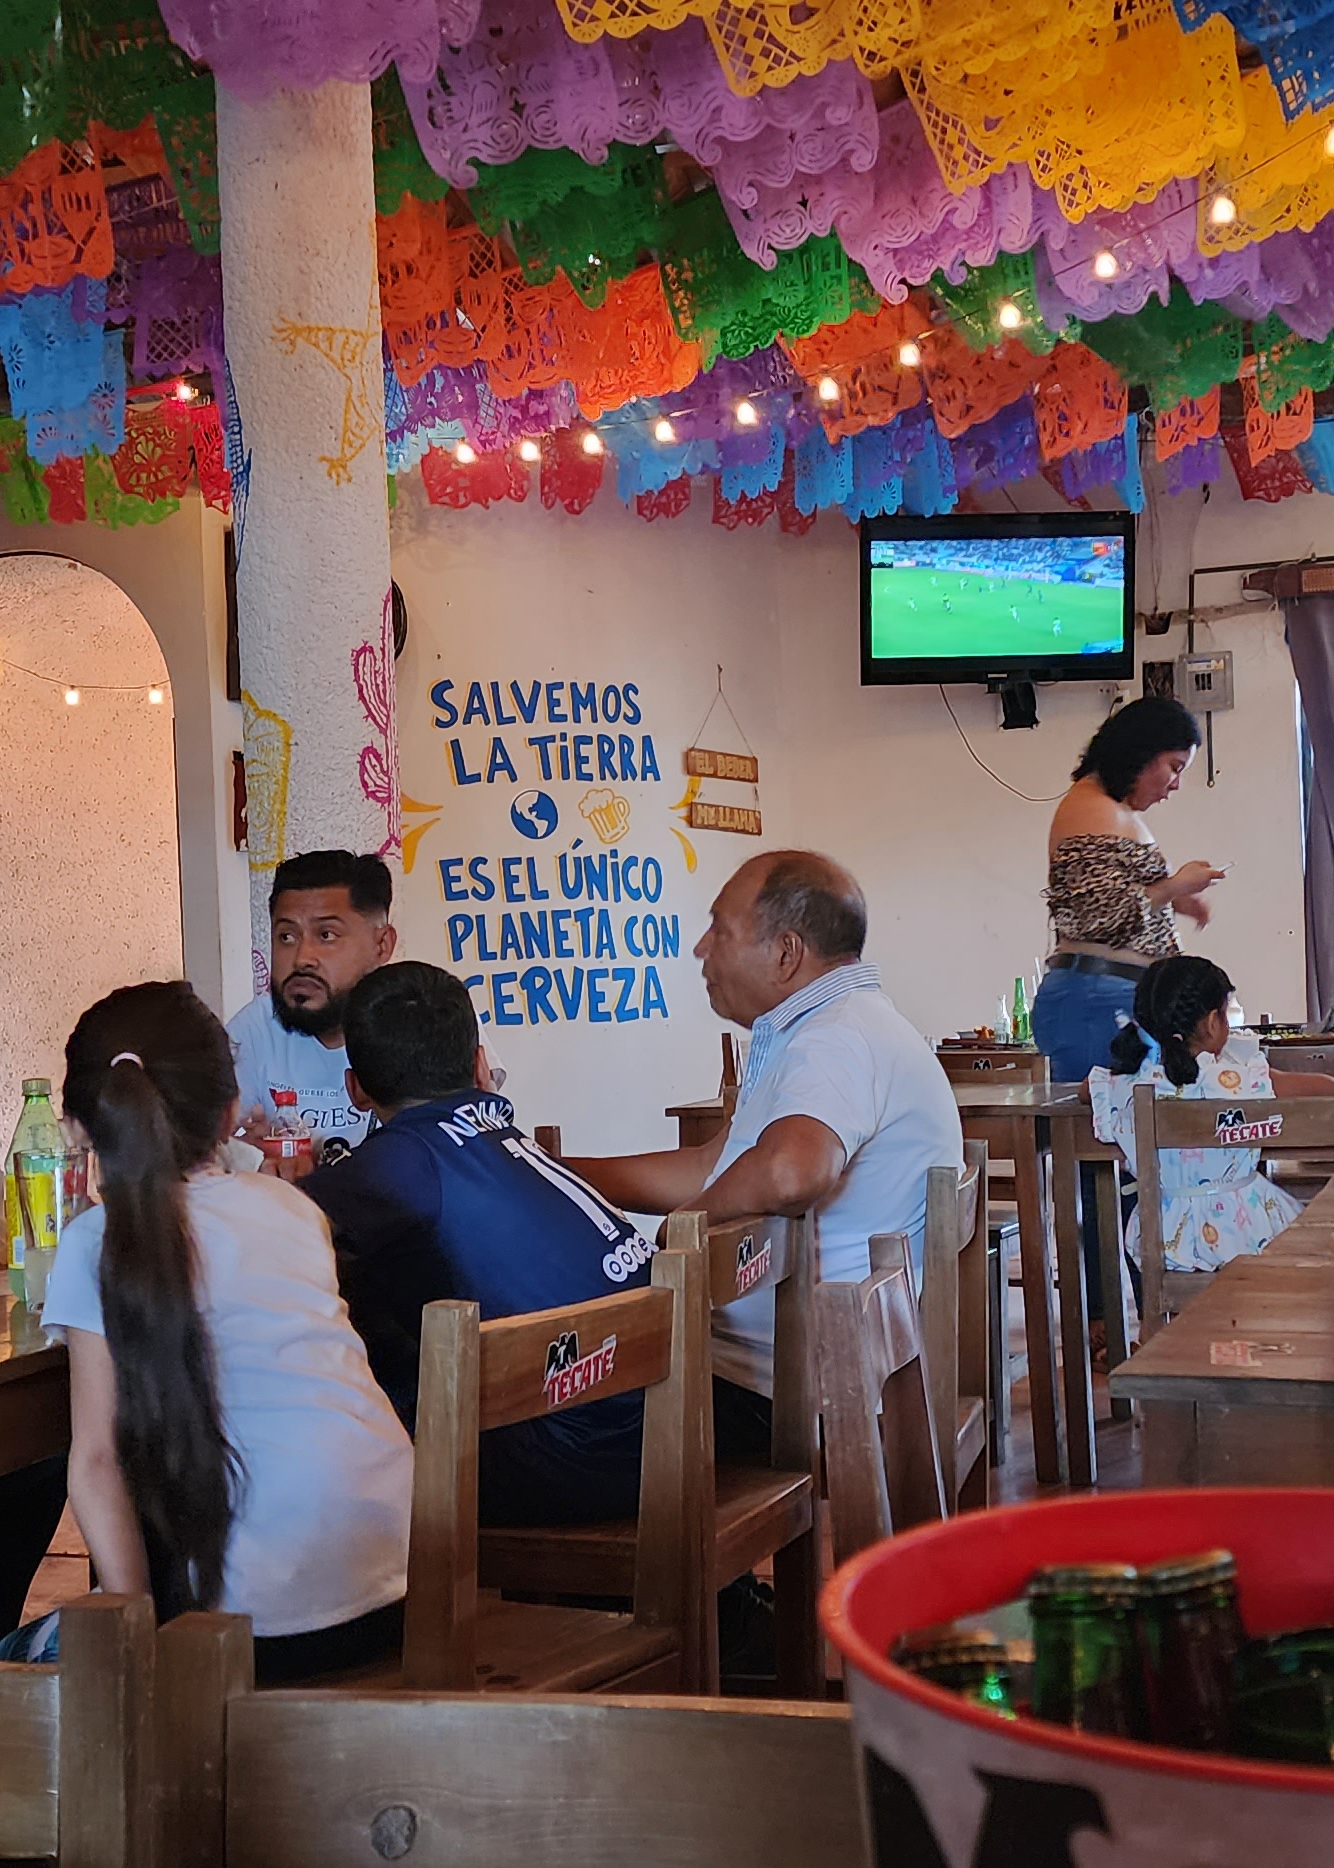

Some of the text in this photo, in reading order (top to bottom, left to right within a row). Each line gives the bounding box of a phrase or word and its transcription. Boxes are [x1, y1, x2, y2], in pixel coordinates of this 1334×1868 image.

[430, 679, 642, 728] SALVEMOS
[447, 735, 518, 786] LA
[438, 856, 495, 902] ES
[503, 856, 550, 903] EL
[447, 907, 681, 963] PLANETA CON
[1219, 1121, 1280, 1143] TECATE
[546, 1346, 614, 1408] TECATE
